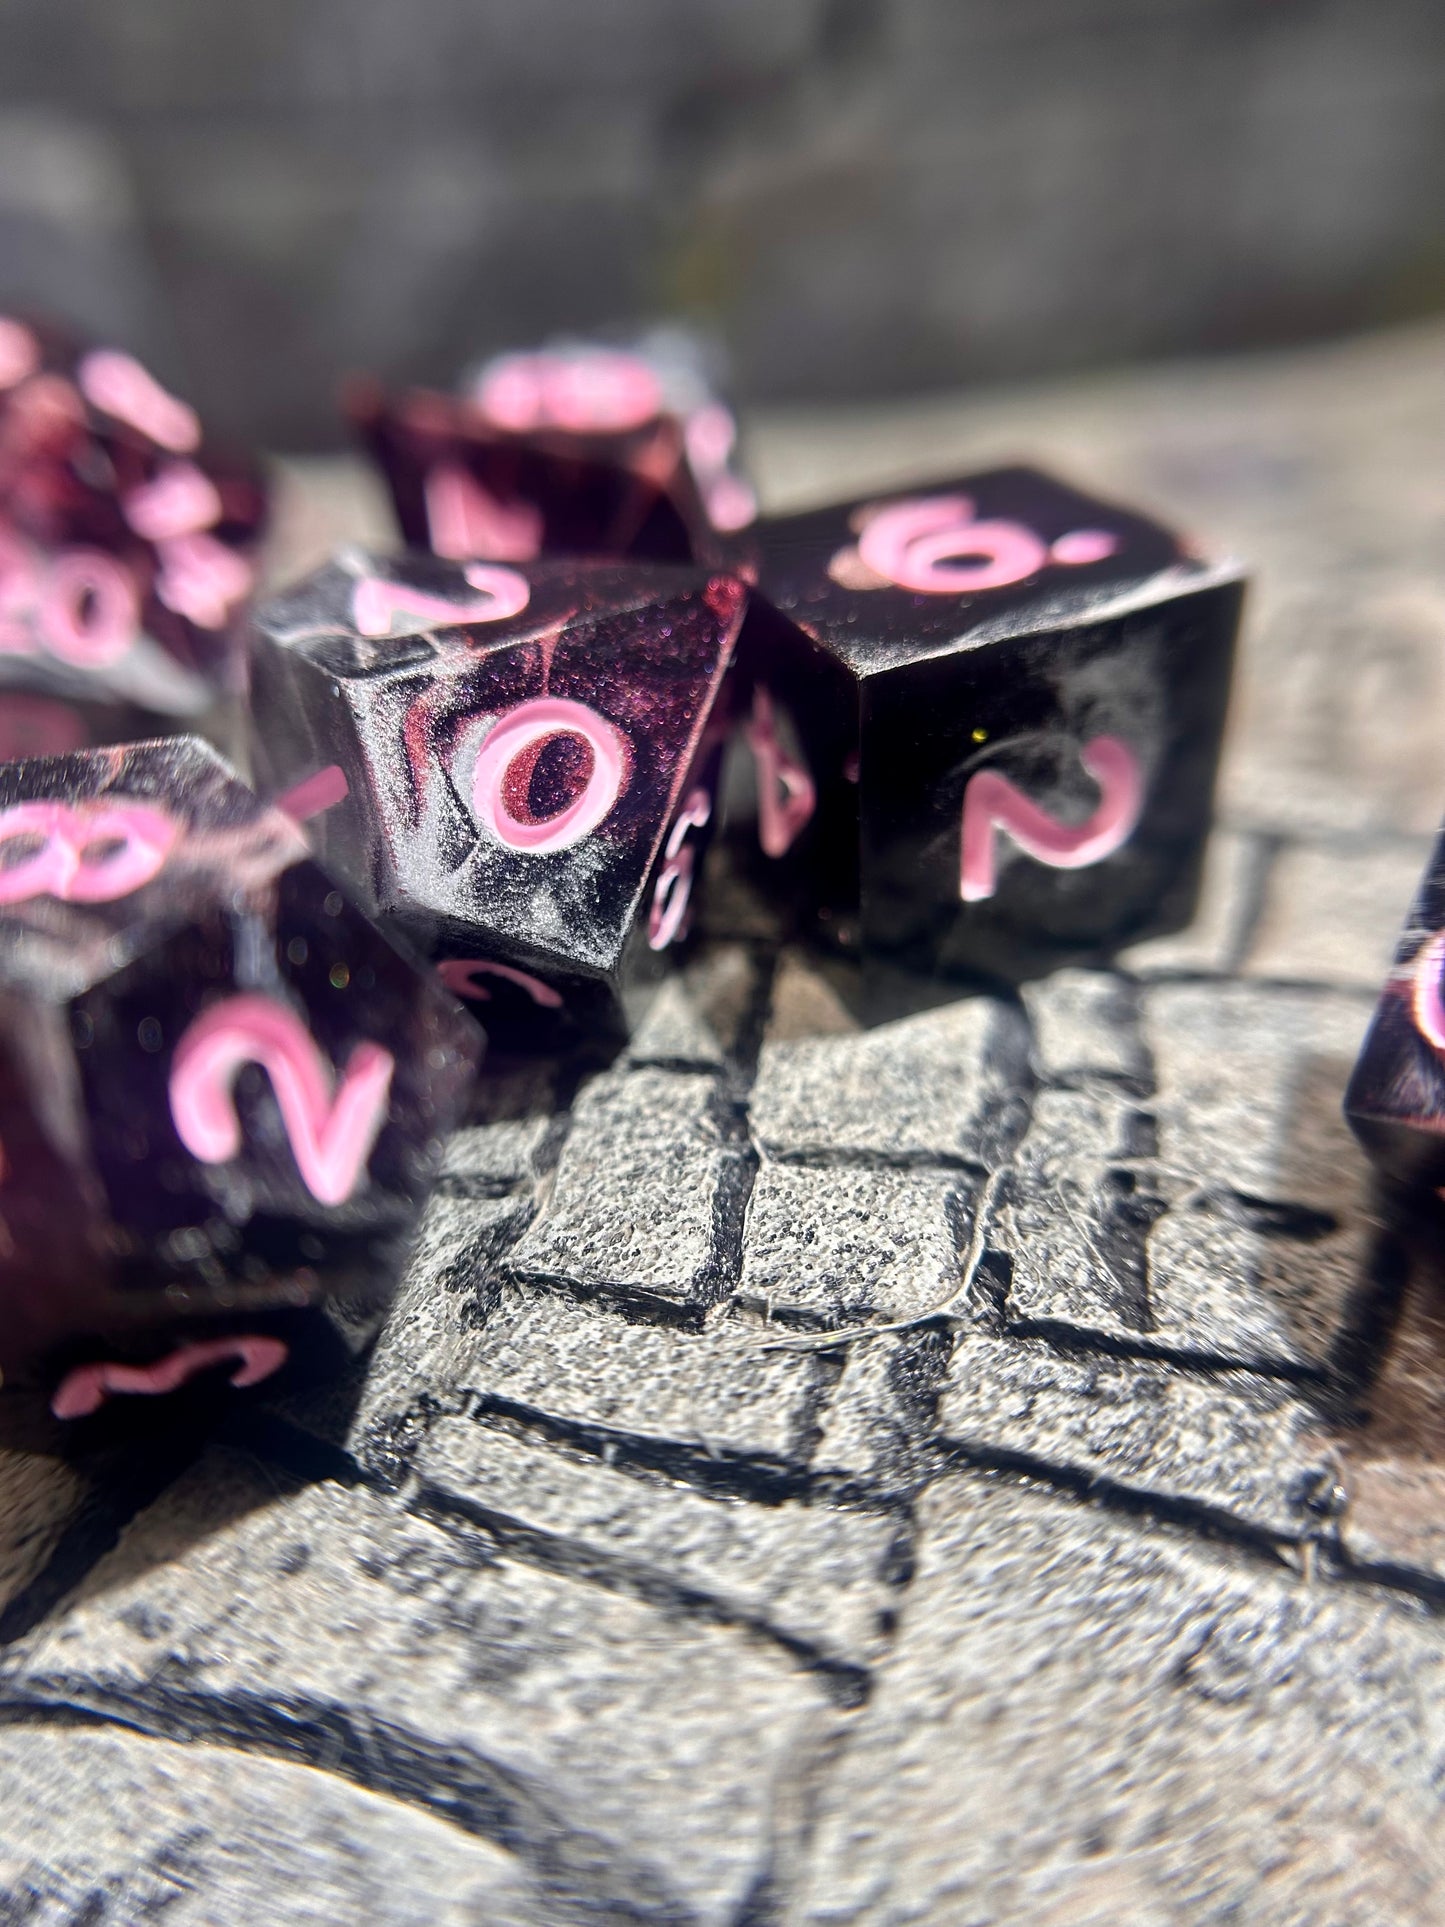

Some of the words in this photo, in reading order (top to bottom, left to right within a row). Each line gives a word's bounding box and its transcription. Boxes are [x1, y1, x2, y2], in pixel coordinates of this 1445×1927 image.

[472, 696, 627, 855] 0
[960, 734, 1146, 902] 2
[168, 993, 394, 1205] 2
